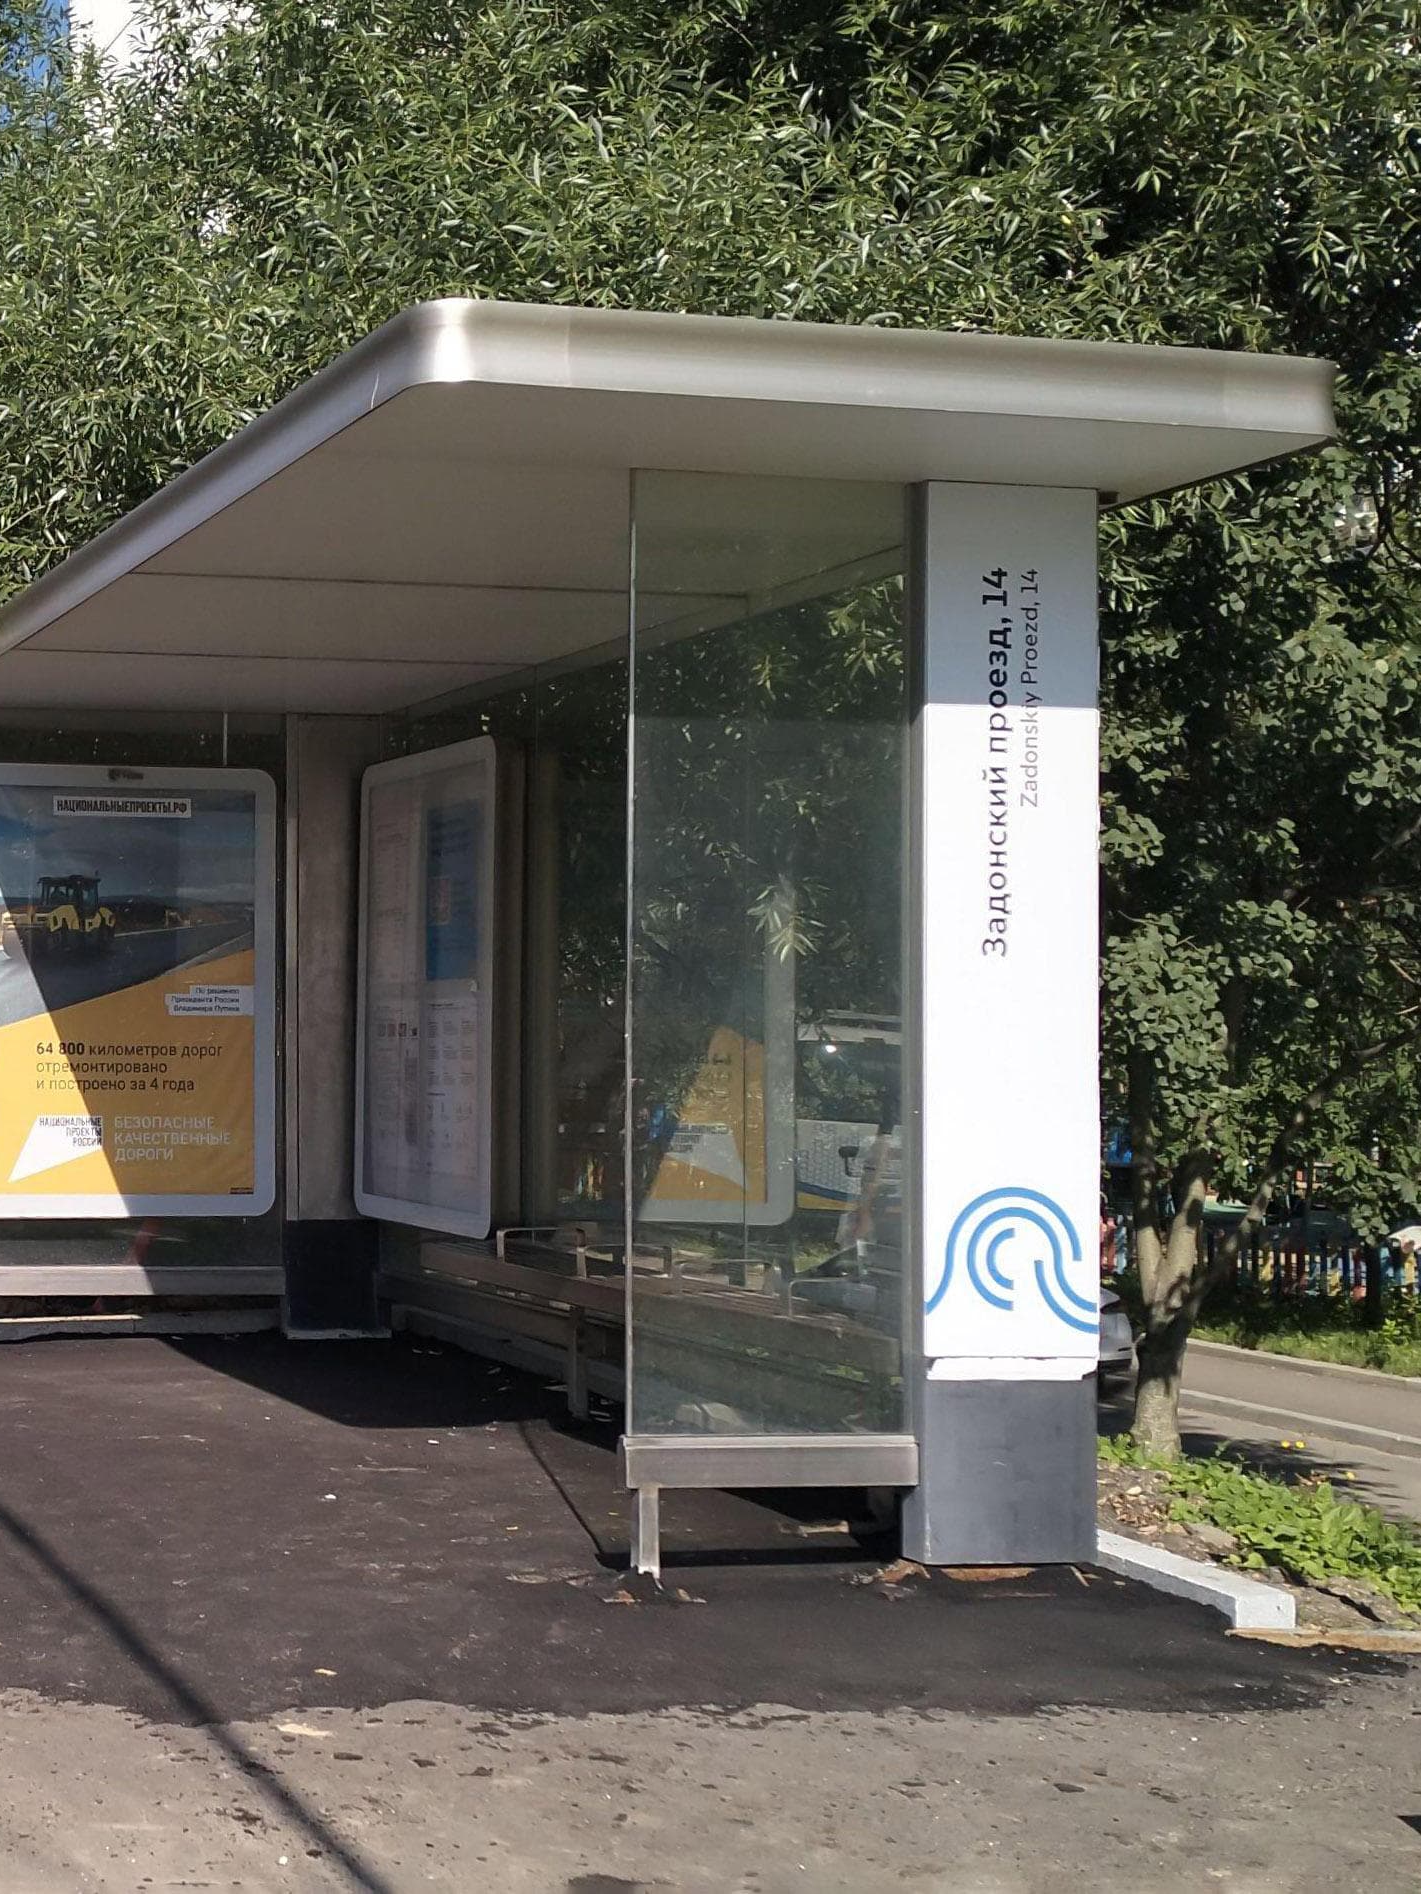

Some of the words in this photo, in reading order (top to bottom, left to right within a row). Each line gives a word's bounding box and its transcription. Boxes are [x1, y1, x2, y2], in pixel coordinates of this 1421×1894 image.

[982, 567, 1008, 607] 14
[1020, 569, 1038, 593] 14
[1020, 602, 1041, 685] Proezd,
[988, 617, 1013, 753] проезд,
[1020, 691, 1042, 808] Zadonskiy
[982, 766, 1011, 957] Задонский
[36, 1041, 54, 1055] 64
[58, 1042, 85, 1056] 800
[89, 1043, 177, 1058] километров
[181, 1044, 223, 1058] дорог
[36, 1060, 168, 1075] отремонтировано
[36, 1079, 45, 1090] и
[49, 1079, 126, 1092] построено
[130, 1079, 146, 1091] за
[149, 1077, 159, 1091] 4
[163, 1079, 196, 1093] года
[39, 1116, 102, 1127] НАЦИОНАЛЬНЫЕ
[113, 1115, 215, 1130] БЕЗОПАСНЫЕ
[65, 1127, 102, 1137] ПРОЕКТЫ
[113, 1131, 231, 1146] КАЧЕСТВЕННЫЕ
[72, 1137, 102, 1147] РОССИИ
[113, 1147, 175, 1163] ДОРОГИ
